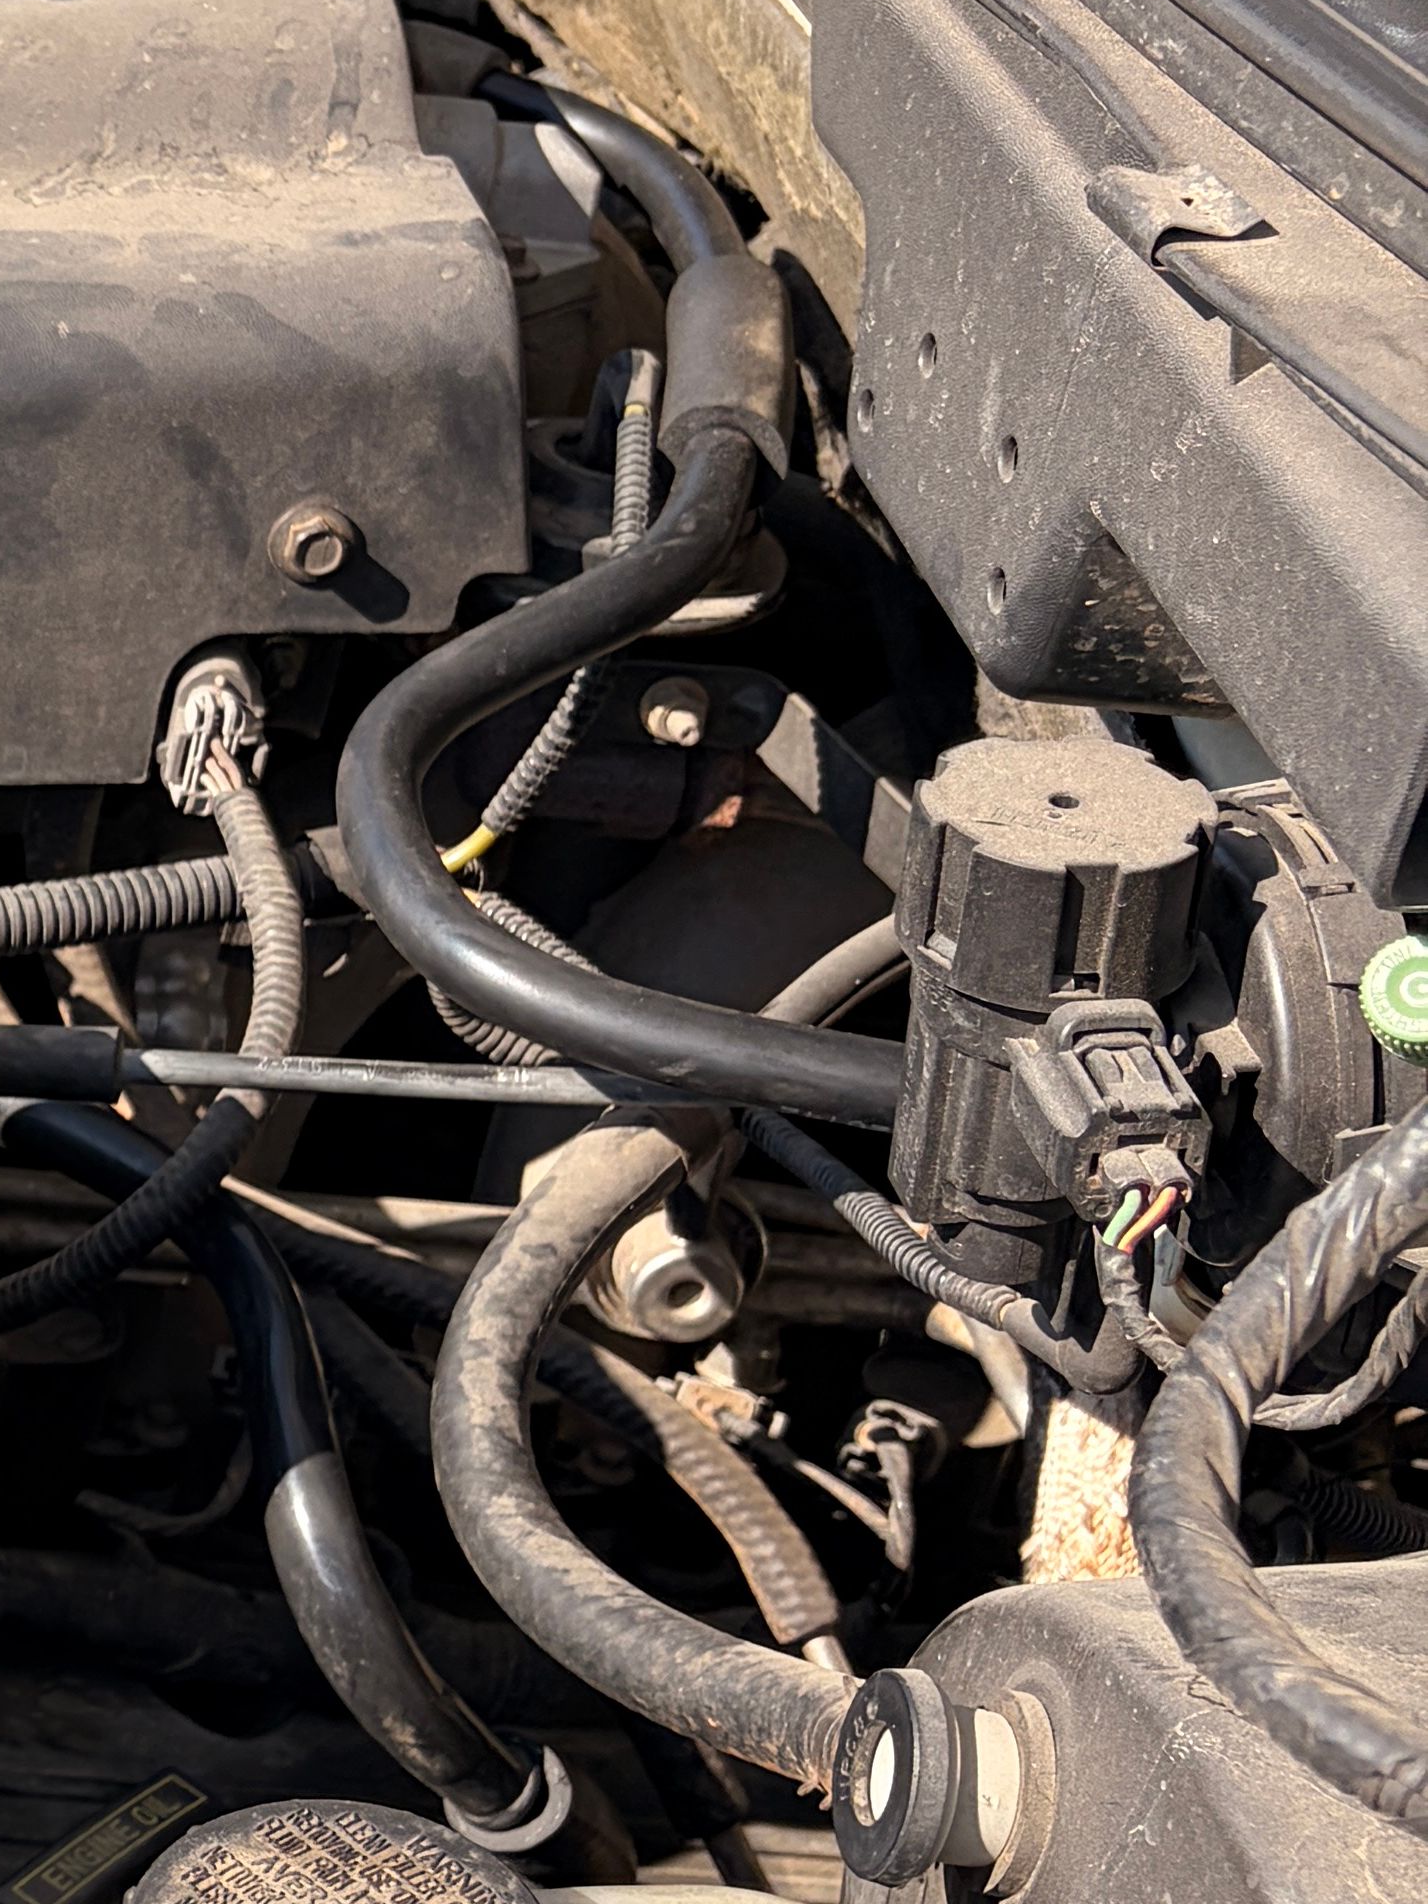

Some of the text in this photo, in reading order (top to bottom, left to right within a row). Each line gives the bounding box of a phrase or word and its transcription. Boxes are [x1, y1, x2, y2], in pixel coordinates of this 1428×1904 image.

[40, 1795, 182, 1893] ENGINE OIL
[254, 1816, 313, 1858] FLUID
[302, 1857, 357, 1891] FROM
[346, 1889, 370, 1904] A
[334, 1811, 392, 1855] CLEAN
[382, 1851, 446, 1900] FILLER
[358, 1864, 401, 1893] USE
